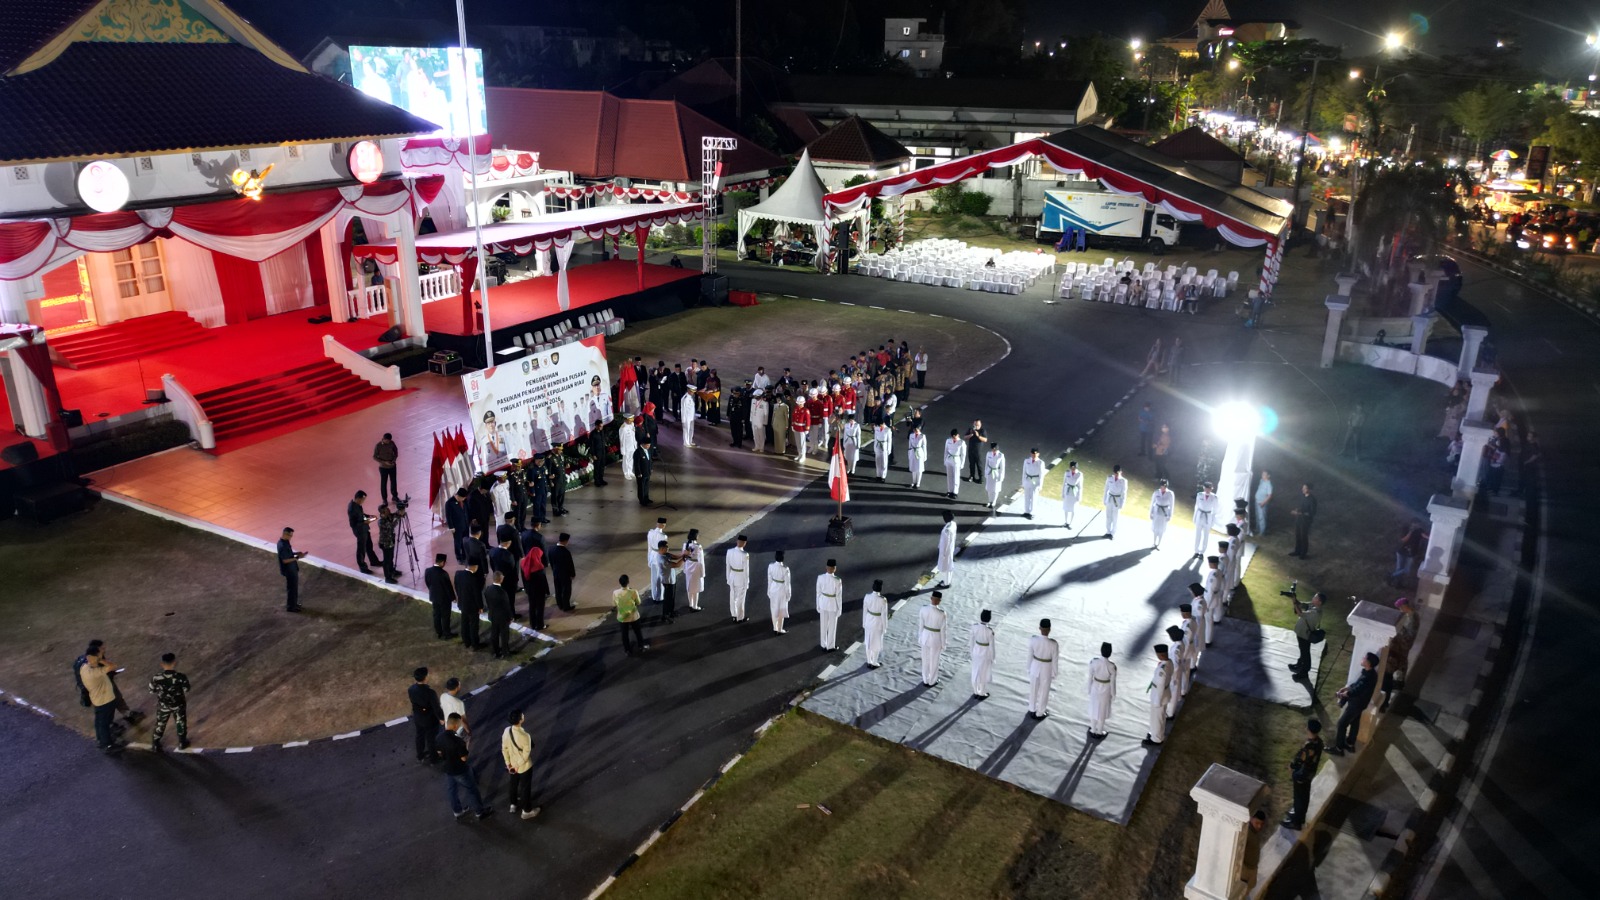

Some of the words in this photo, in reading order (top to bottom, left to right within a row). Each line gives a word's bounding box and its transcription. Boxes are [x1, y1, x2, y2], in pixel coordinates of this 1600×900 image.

[497, 392, 521, 405] PASUKAN
[521, 383, 547, 397] PENGIBAR
[547, 376, 568, 389] BENDERA
[569, 370, 587, 382] PUSAKA
[525, 371, 559, 387] PENGUKUHAN
[500, 401, 522, 414] TINGKAT
[522, 393, 547, 405] PROVINSI
[546, 384, 574, 398] KEPULAUAN
[574, 379, 585, 387] RIAU
[531, 400, 549, 411] TAHUN
[549, 395, 562, 405] 2026
